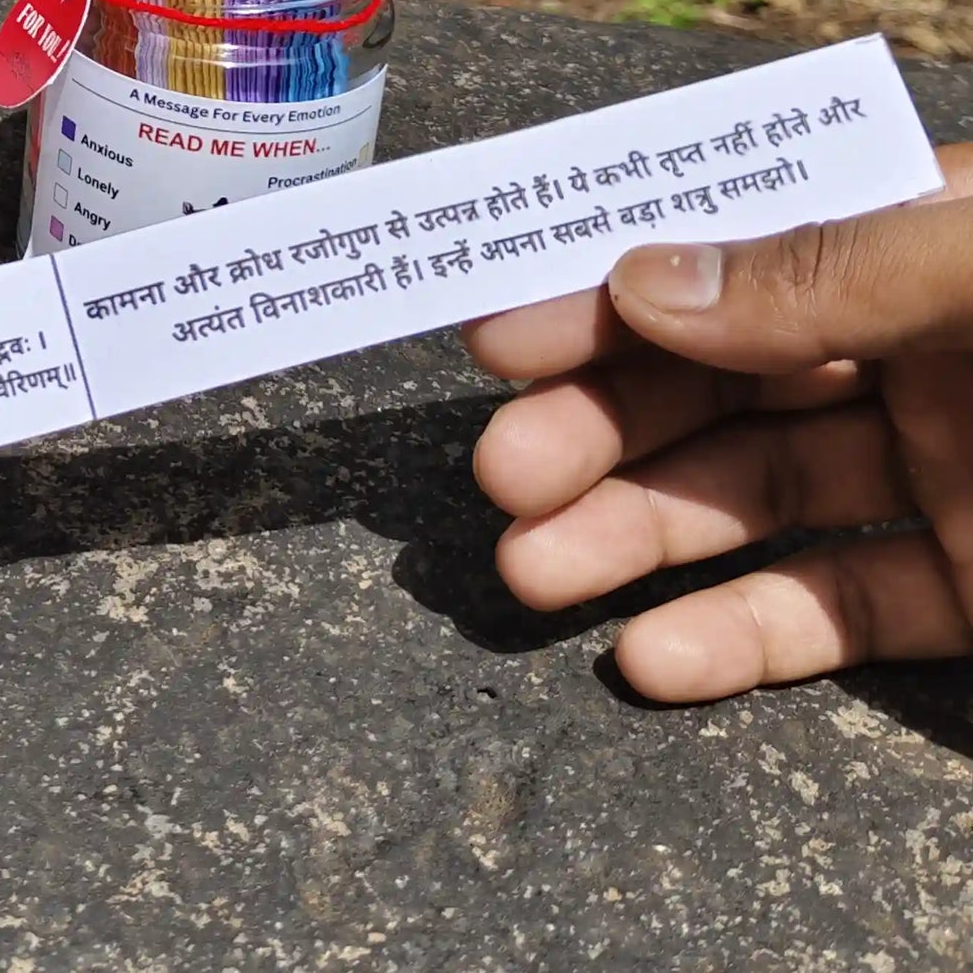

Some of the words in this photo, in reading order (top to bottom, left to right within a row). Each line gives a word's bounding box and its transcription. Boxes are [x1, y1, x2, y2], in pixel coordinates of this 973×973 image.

[16, 3, 45, 38] FOR
[130, 88, 140, 101] A
[144, 95, 209, 119] Message
[213, 108, 239, 121] For
[242, 111, 284, 125] Every
[288, 104, 341, 122] Emotion
[81, 133, 134, 168] Anxious
[138, 122, 202, 152] READ
[210, 139, 245, 157] ME
[252, 137, 331, 159] WHEN...
[77, 168, 119, 199] Lonely
[268, 157, 358, 189] Procrastination
[74, 202, 112, 231] Angry
[84, 280, 167, 322] कामना
[173, 264, 221, 295] और
[227, 248, 284, 282] क्रोध
[289, 228, 381, 262] रजोगुण
[385, 210, 411, 239] से
[415, 198, 481, 233] उत्पन्न
[484, 182, 530, 221] होते
[569, 167, 591, 194] ये
[594, 151, 652, 187] कभी
[657, 142, 706, 178] तृप्त
[711, 121, 758, 156] नहीं
[762, 108, 811, 147] होते
[818, 96, 868, 125] और
[172, 306, 246, 344] अत्यंत
[249, 262, 388, 322] विनाशकारी
[429, 239, 474, 278] इन्हें
[480, 228, 547, 263] अपना
[552, 205, 613, 241] सबसे
[618, 198, 667, 228] बड़ा
[671, 184, 719, 213] शत्रु
